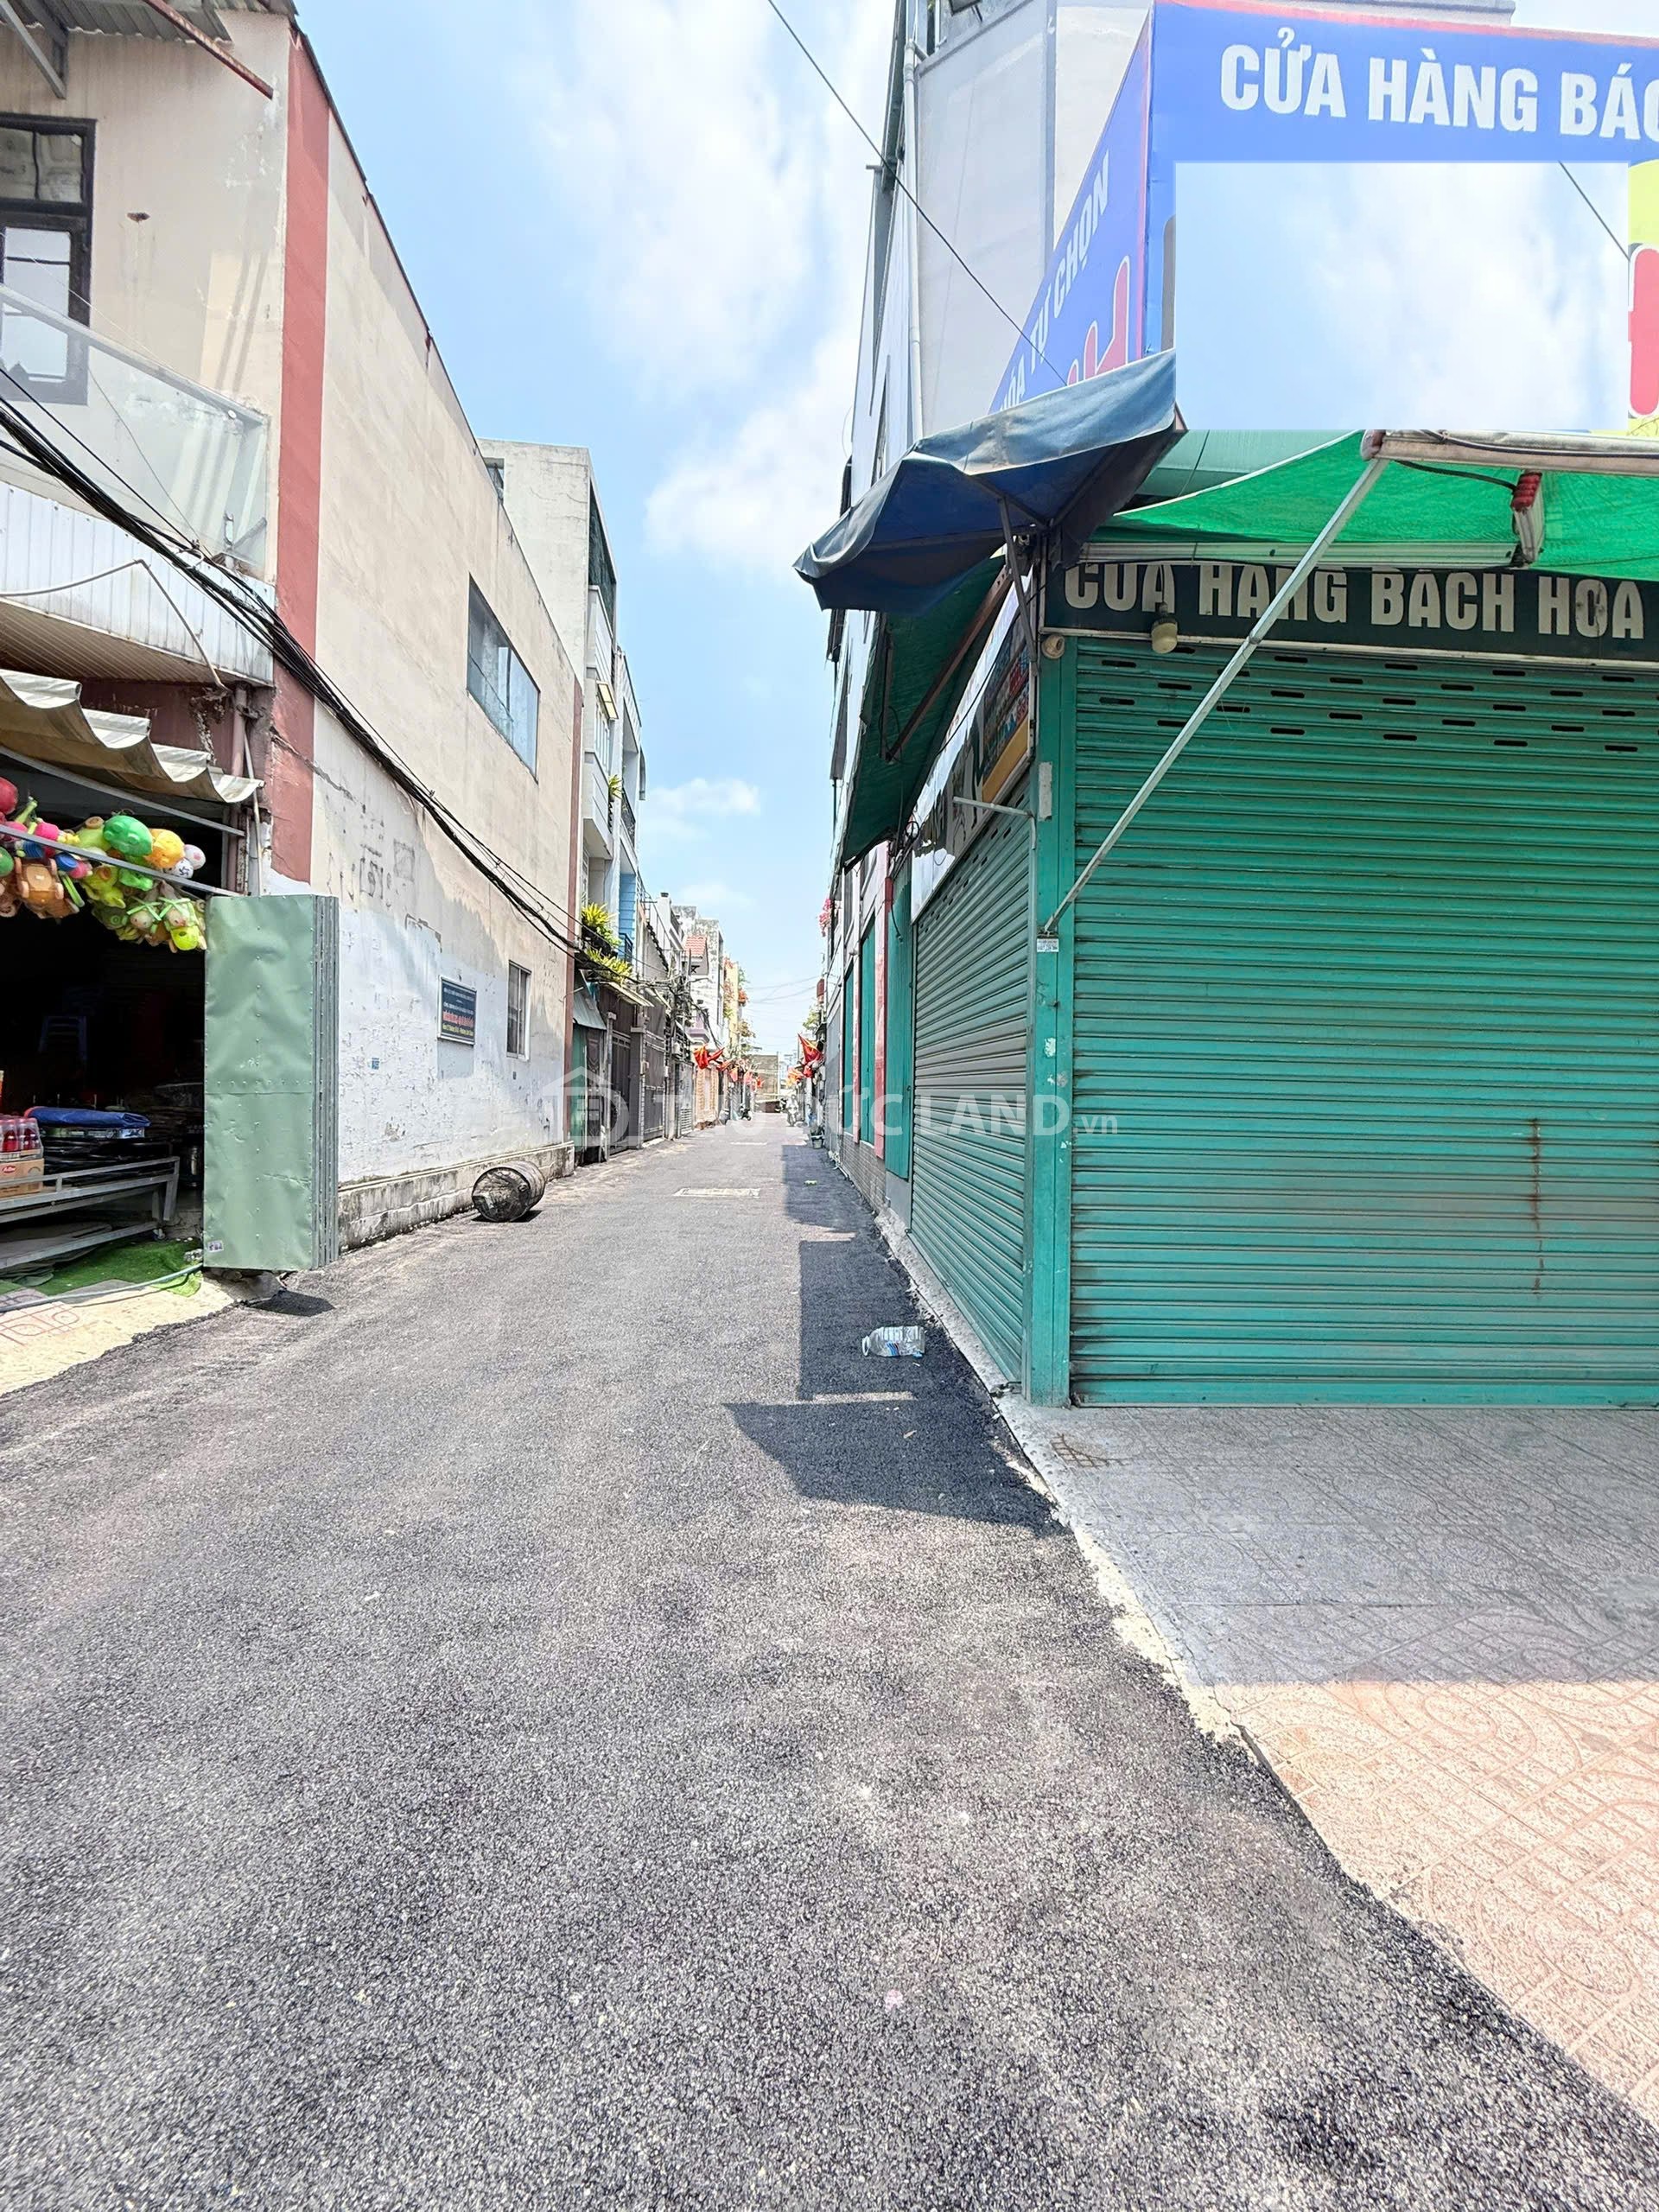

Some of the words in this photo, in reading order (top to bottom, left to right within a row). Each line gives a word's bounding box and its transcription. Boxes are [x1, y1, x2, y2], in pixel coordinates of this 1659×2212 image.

[1220, 27, 1346, 118] CỬA
[1367, 48, 1537, 132] HÀNG
[1053, 149, 1109, 318] CHỌN
